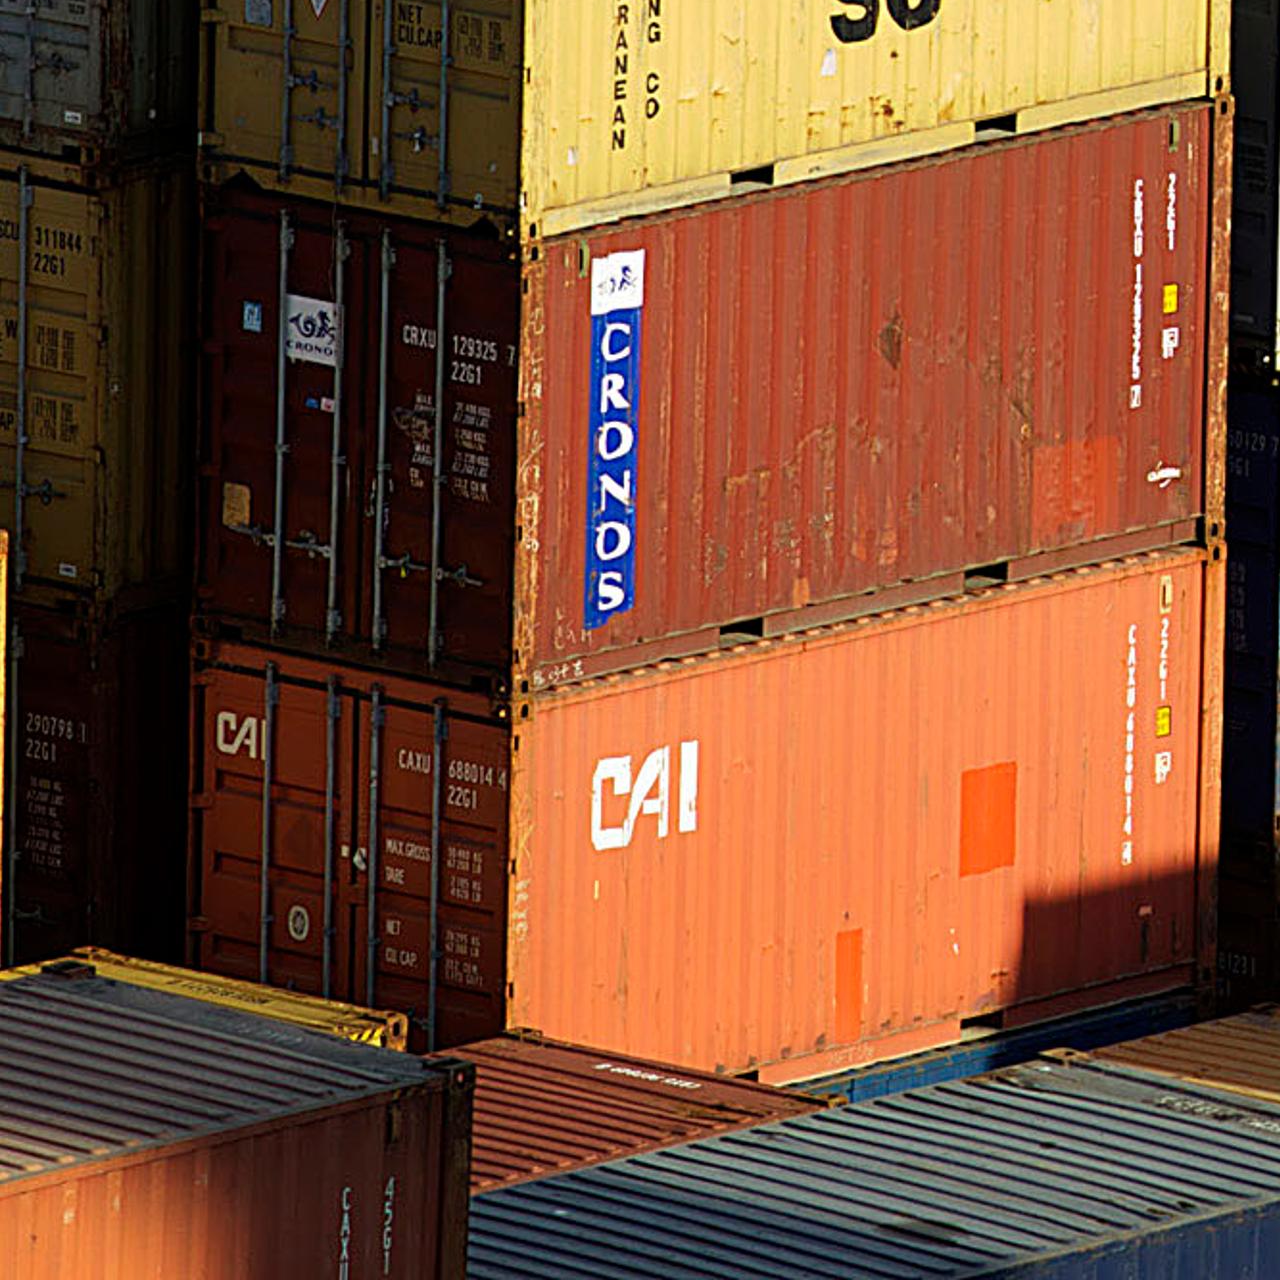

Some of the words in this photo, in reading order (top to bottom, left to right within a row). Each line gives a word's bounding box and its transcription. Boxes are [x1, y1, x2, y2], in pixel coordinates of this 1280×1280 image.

[645, 73, 660, 120] CO
[33, 252, 66, 277] 22G1
[286, 342, 334, 358] CRONO
[402, 324, 436, 349] CRXU
[451, 334, 498, 362] 129325
[451, 360, 482, 386] 22G1
[593, 321, 633, 612] CRONOS
[1158, 617, 1168, 700] 22G1
[25, 712, 75, 742] 290798
[24, 738, 58, 764] 22G1
[399, 748, 432, 774] CAXU
[448, 761, 494, 791] 688014
[446, 783, 477, 810] 22G1
[590, 739, 699, 852] CAI
[383, 1175, 395, 1277] 45G1
